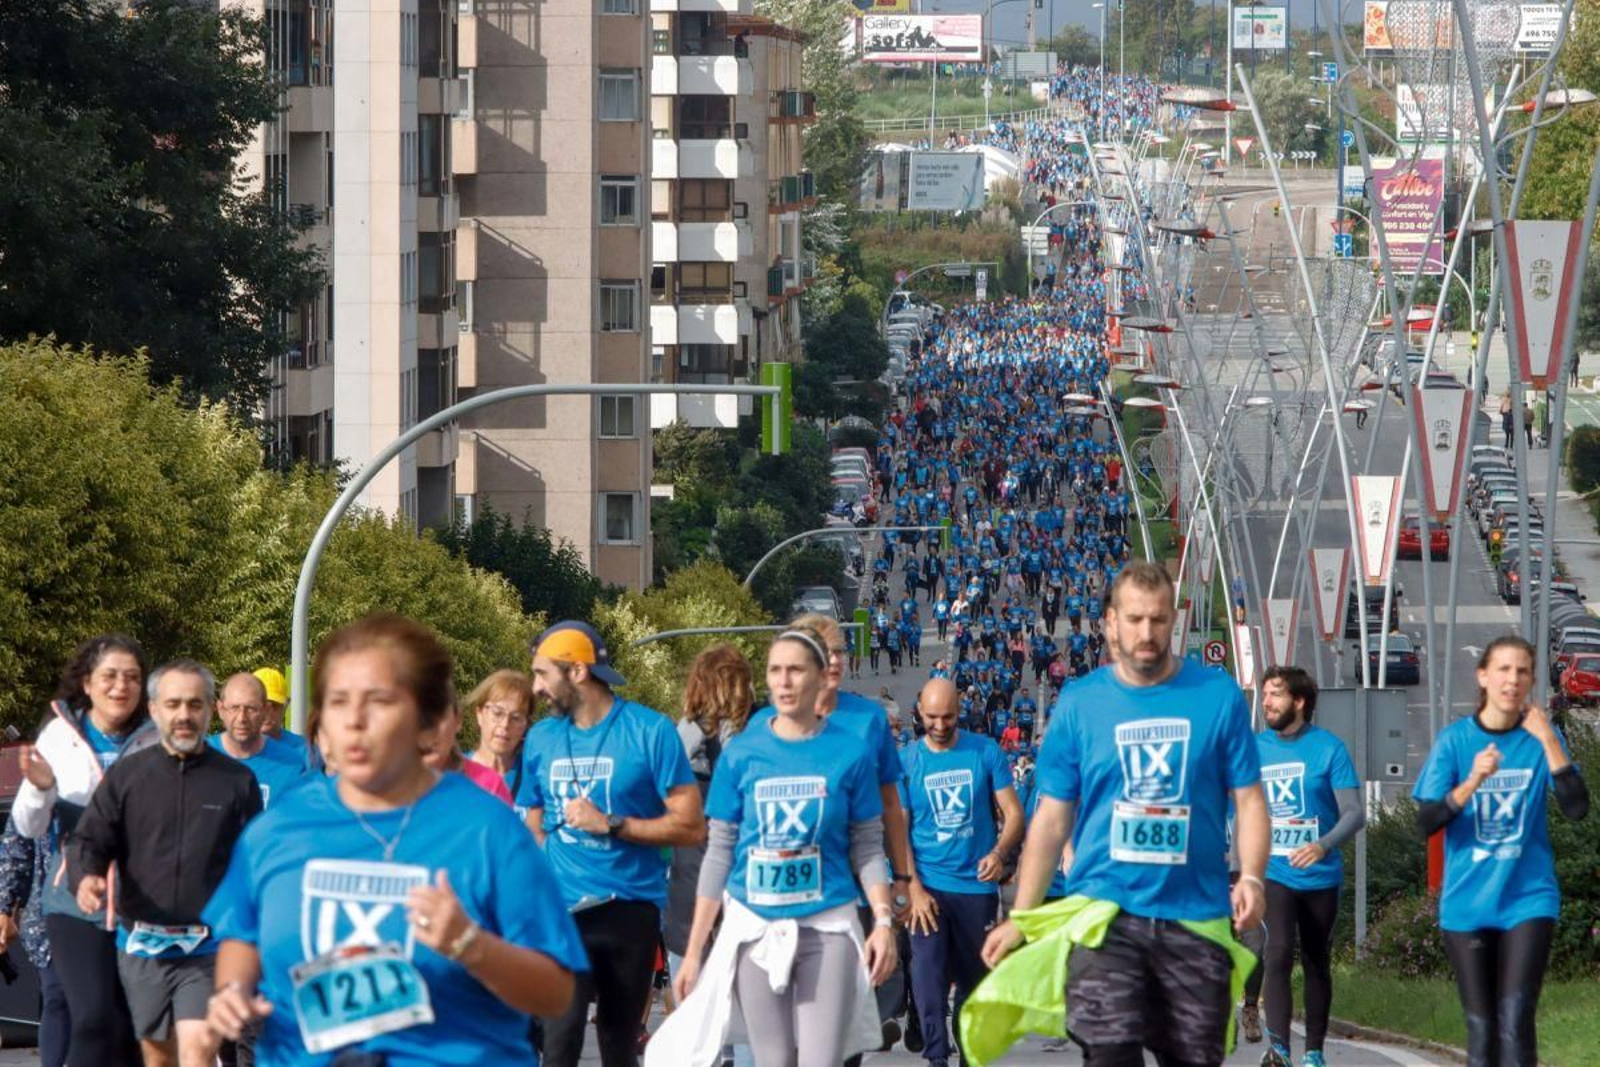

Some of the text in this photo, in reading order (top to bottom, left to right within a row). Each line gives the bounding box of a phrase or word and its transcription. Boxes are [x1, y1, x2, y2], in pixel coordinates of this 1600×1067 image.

[864, 16, 912, 31] Gallery
[1130, 742, 1173, 778] IX
[935, 786, 966, 811] IX
[1267, 778, 1296, 803] IX
[766, 800, 809, 834] IX
[1481, 791, 1519, 820] IX
[1122, 820, 1180, 847] 1688
[1273, 829, 1313, 844] 2774
[757, 862, 813, 888] 1789
[316, 899, 395, 955] IX
